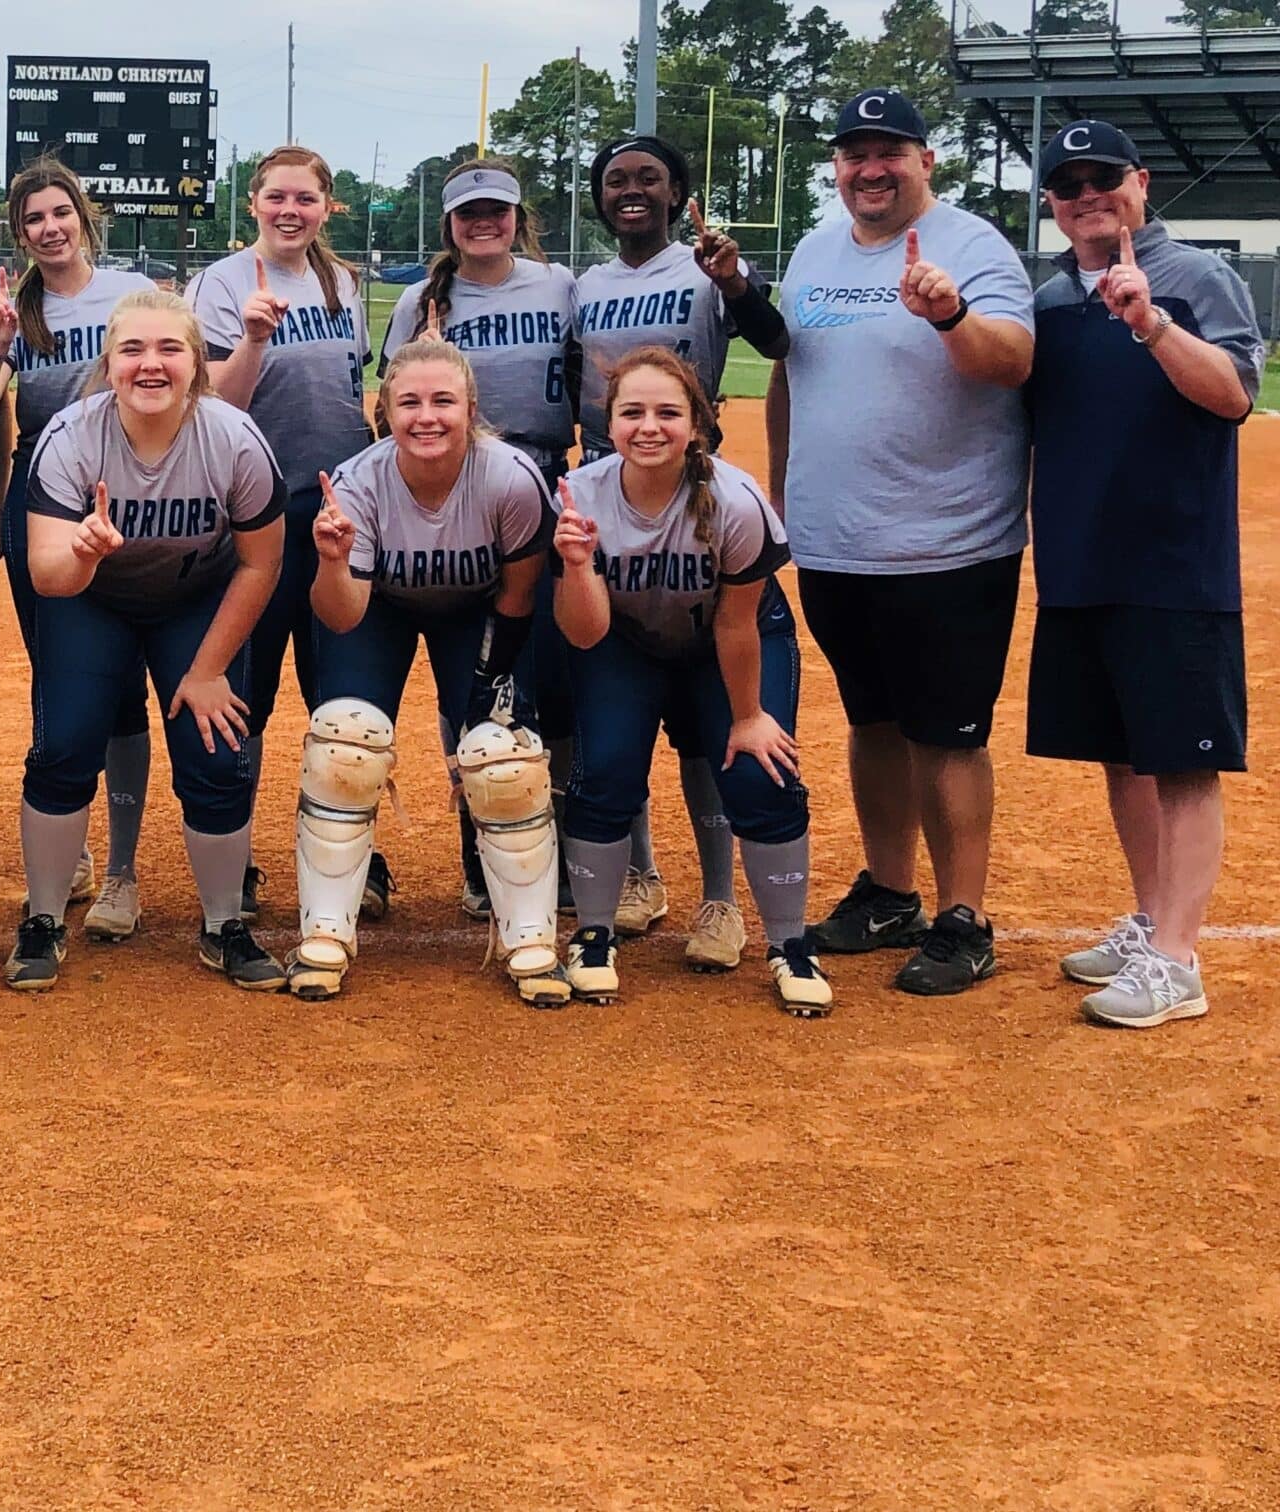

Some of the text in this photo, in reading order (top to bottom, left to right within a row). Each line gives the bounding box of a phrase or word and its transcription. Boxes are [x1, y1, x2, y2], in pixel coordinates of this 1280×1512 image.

[15, 65, 205, 84] NORTHLAND CHRISTIAN
[8, 88, 59, 102] COUGARS
[168, 92, 202, 105] GUEST
[858, 96, 886, 119] C
[16, 131, 40, 143] BALL
[65, 132, 99, 144] STRIKE
[127, 133, 147, 145] OUT
[182, 136, 190, 148] H
[1063, 127, 1092, 151] C
[182, 158, 190, 170] E
[79, 176, 170, 196] FTBALL
[808, 287, 900, 304] CYPRESS
[544, 356, 564, 405] 6
